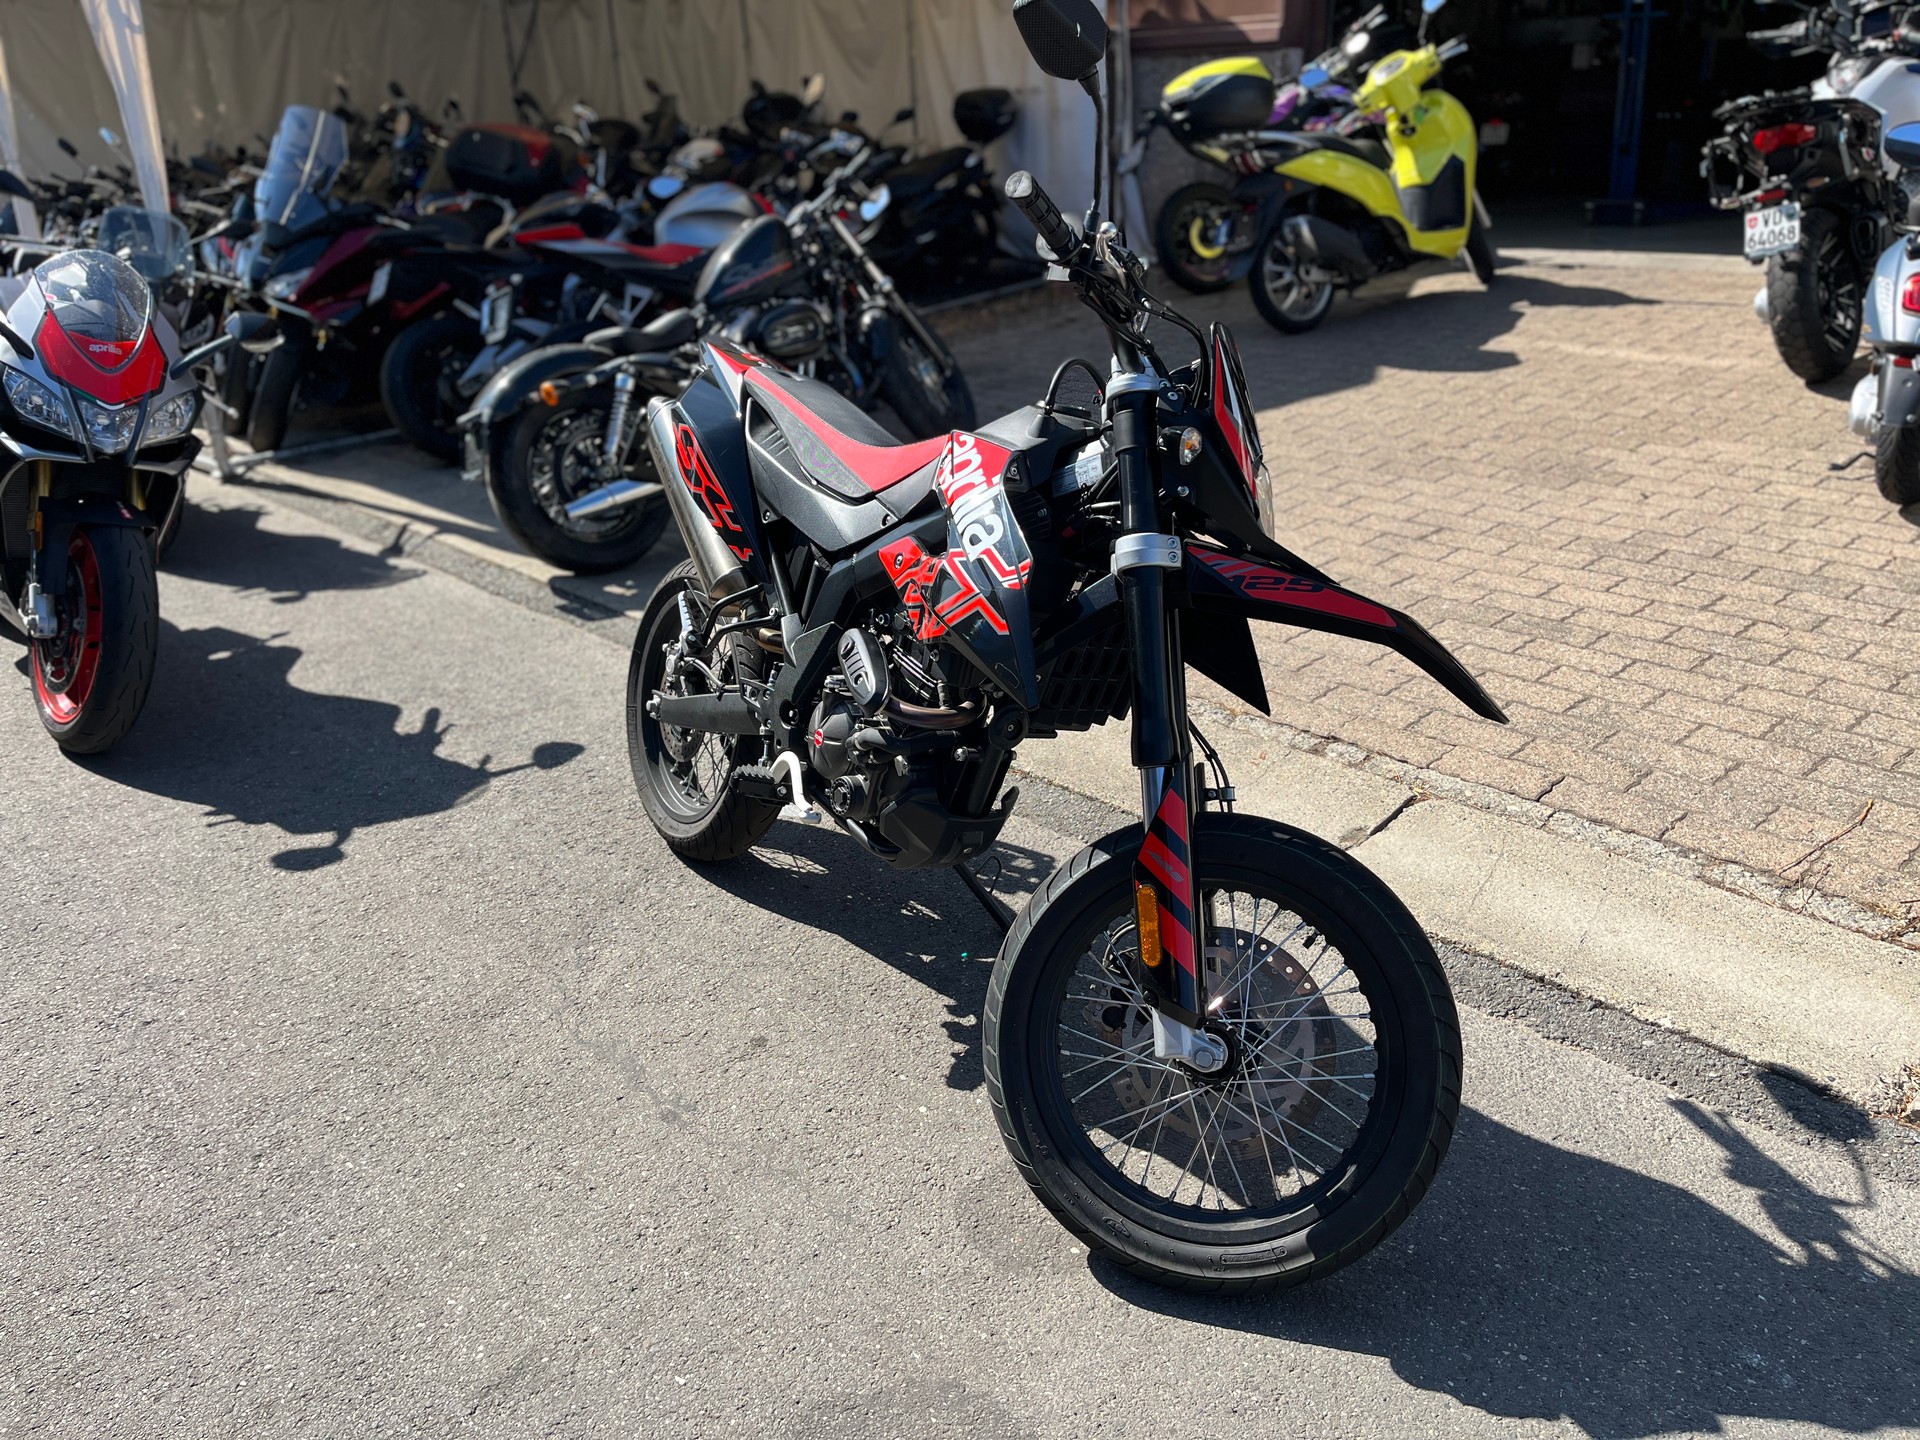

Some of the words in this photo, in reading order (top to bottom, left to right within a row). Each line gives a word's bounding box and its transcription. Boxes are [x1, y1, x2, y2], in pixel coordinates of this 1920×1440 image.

[1762, 208, 1782, 228] VD
[1748, 225, 1796, 249] 64068
[89, 343, 122, 355] aprilia
[938, 434, 1004, 562] aprilia
[1228, 574, 1326, 593] 125
